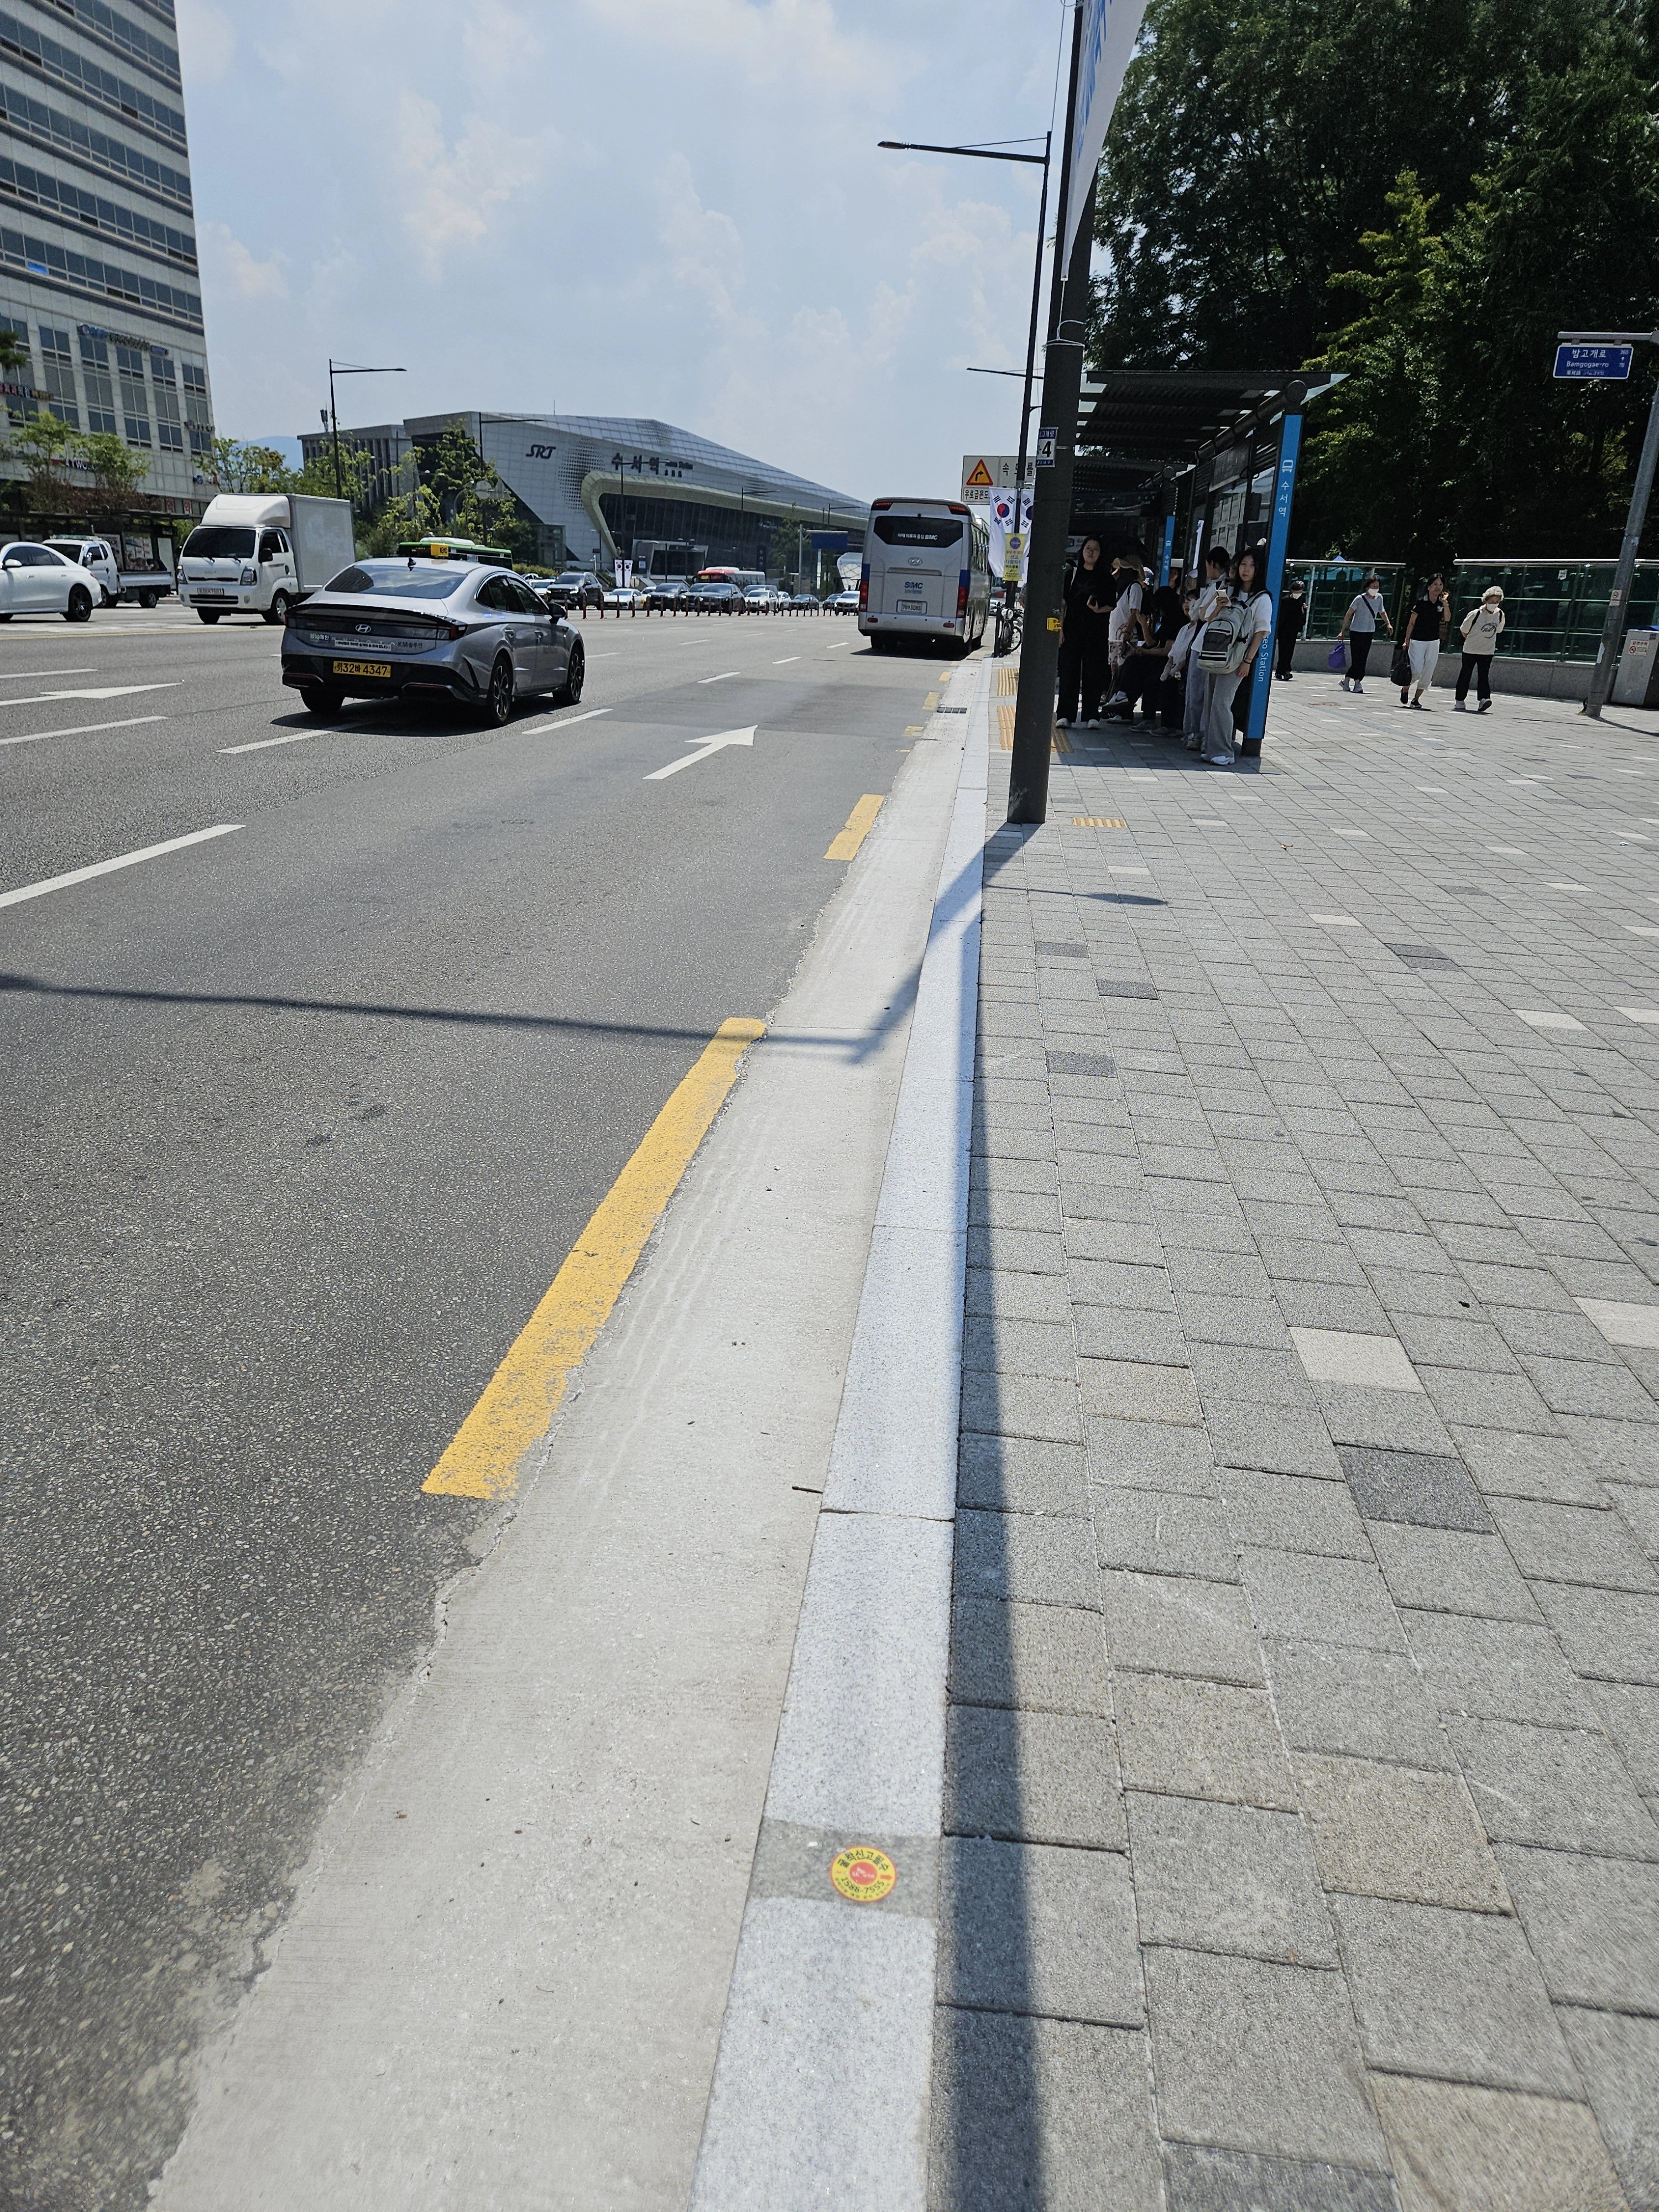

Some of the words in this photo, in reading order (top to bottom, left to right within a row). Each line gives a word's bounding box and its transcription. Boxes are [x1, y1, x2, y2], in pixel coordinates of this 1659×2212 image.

[1572, 349, 1606, 358] 밤고개로
[526, 444, 556, 459] SRT
[611, 452, 660, 475] 수서역
[1279, 481, 1290, 517] 수서역
[1258, 652, 1269, 682] Station
